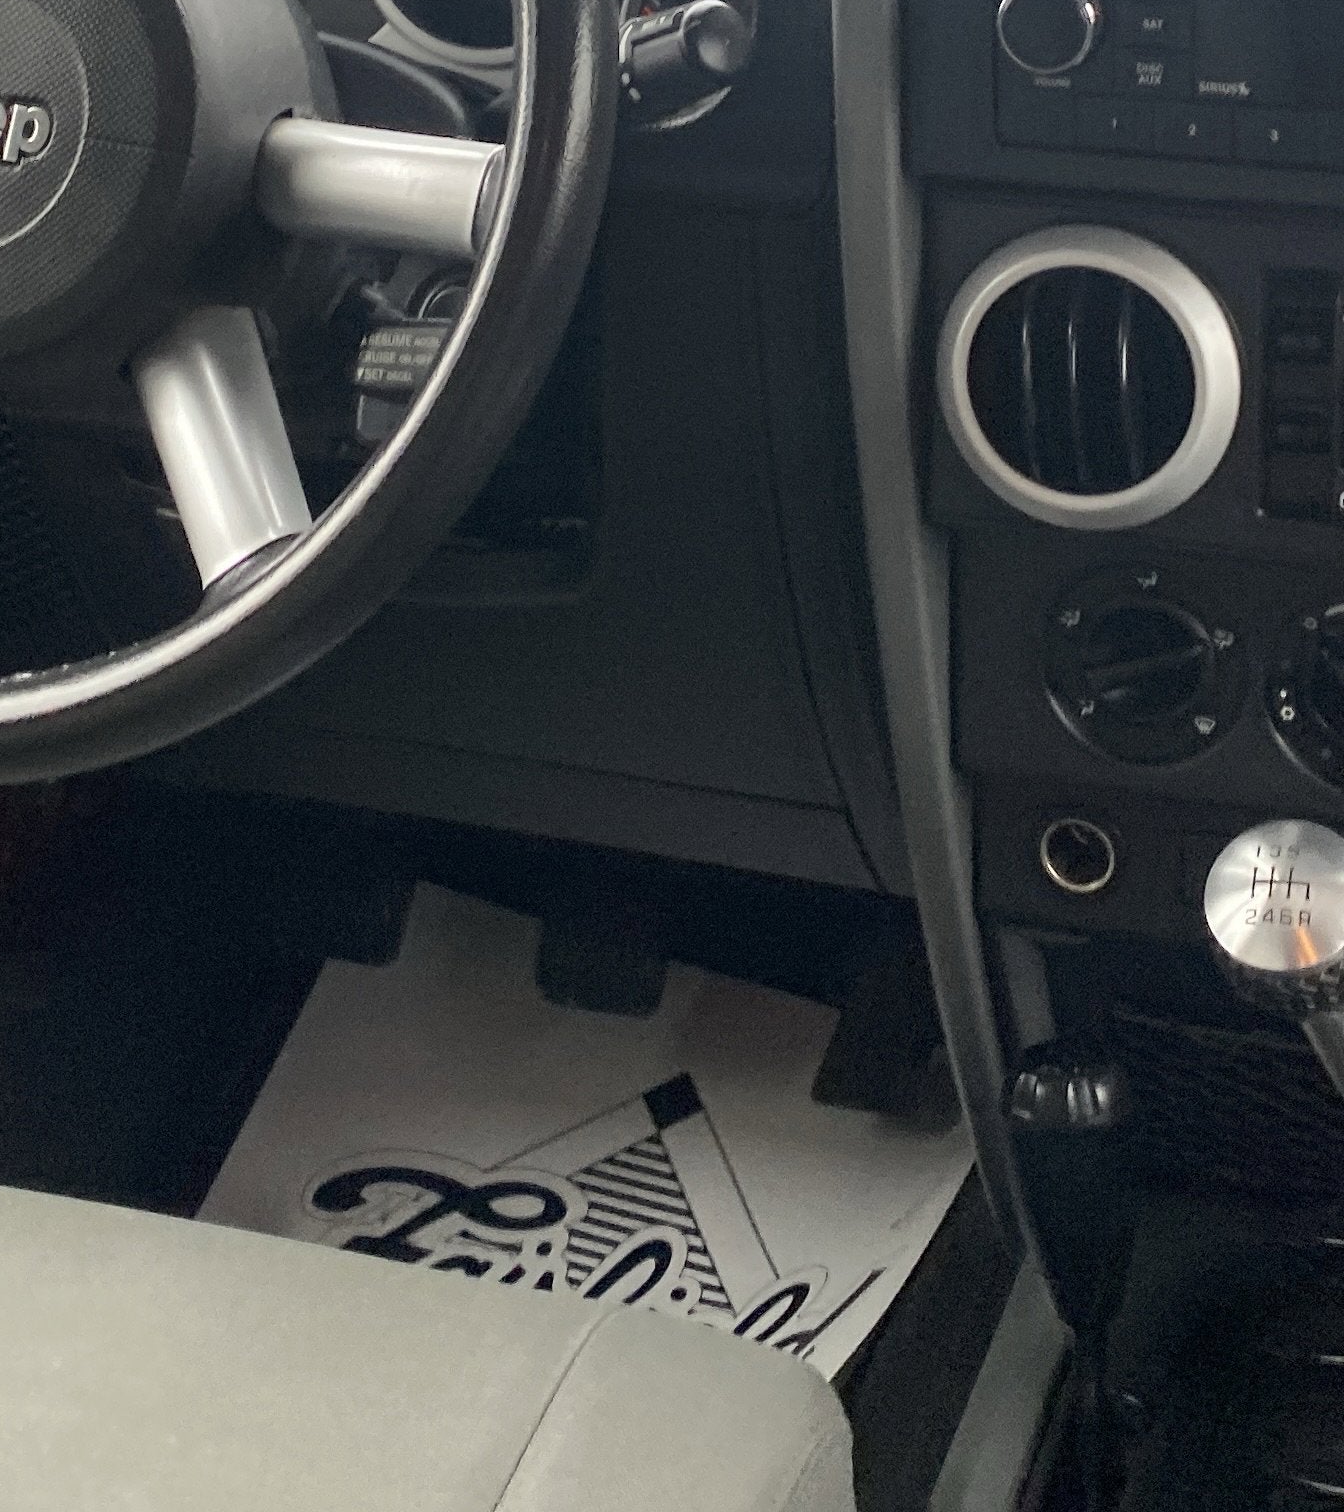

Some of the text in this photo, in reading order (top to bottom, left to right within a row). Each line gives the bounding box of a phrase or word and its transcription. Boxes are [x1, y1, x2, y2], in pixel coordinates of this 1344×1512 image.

[1142, 18, 1164, 30] SAT
[1187, 123, 1198, 137] 2
[1269, 128, 1280, 143] 3
